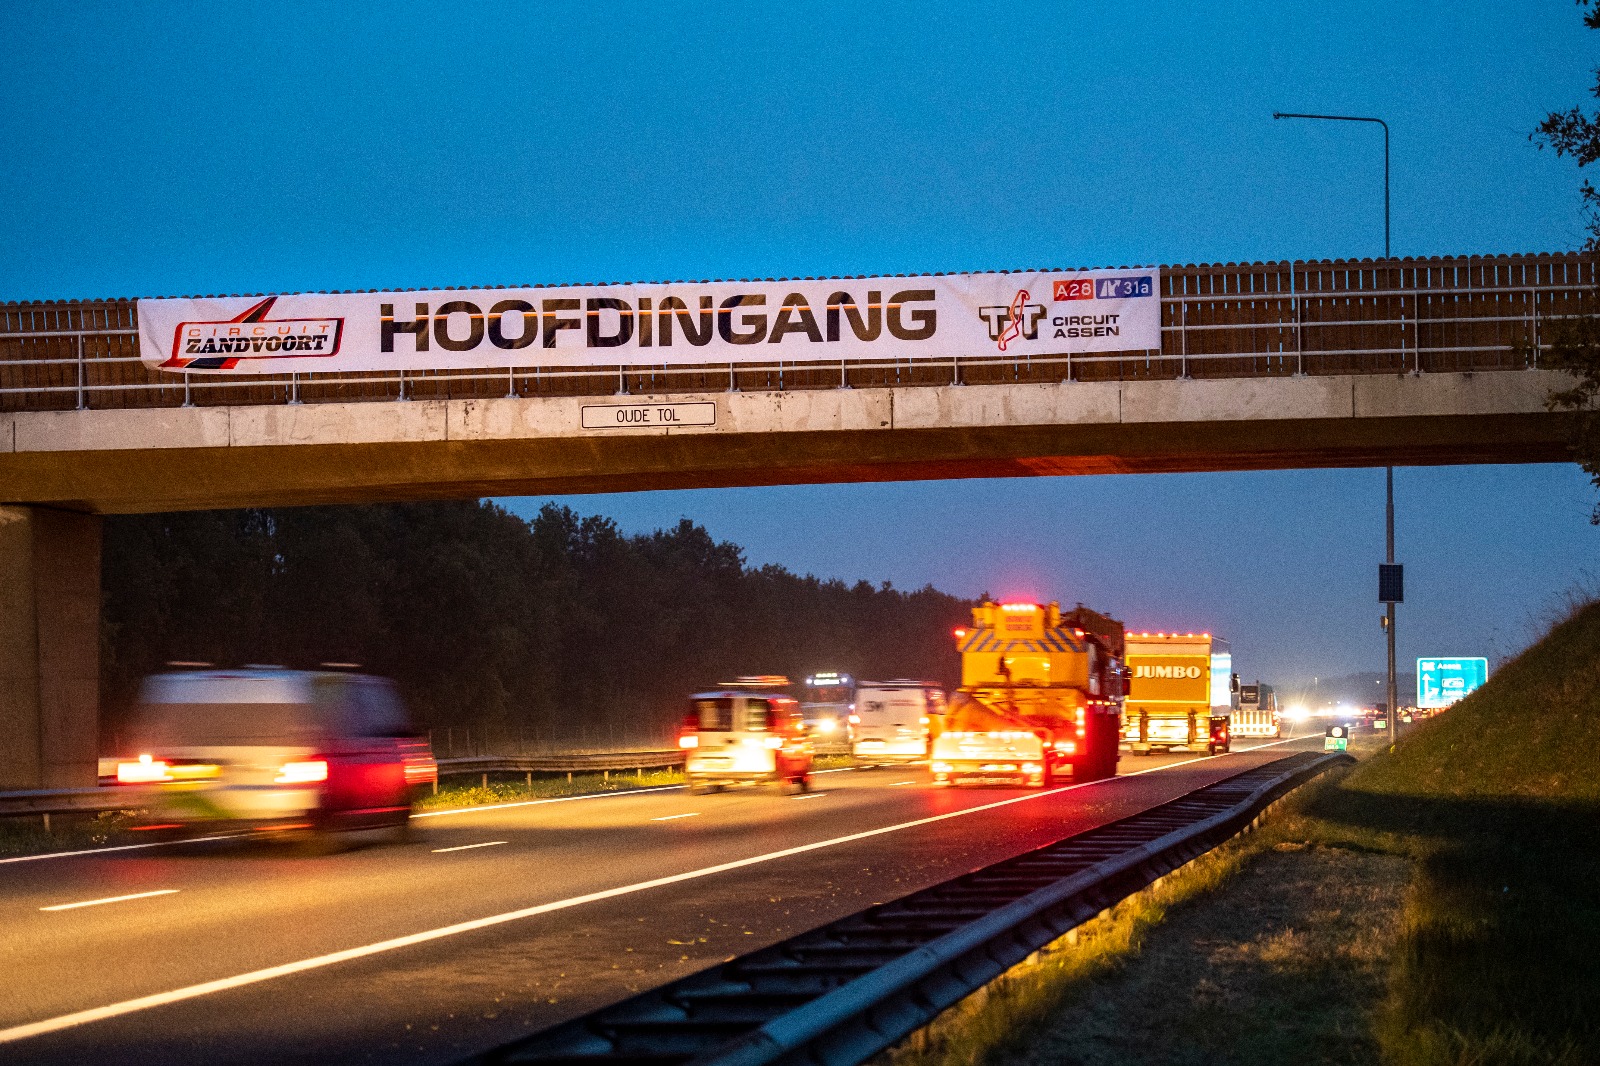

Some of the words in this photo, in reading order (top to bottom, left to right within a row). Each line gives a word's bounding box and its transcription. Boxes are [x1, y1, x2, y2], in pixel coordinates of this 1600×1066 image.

[1056, 283, 1092, 298] A28
[1124, 281, 1149, 295] 31a
[381, 290, 937, 352] HOOFDINGANG
[1052, 314, 1120, 327] CIRCUIT
[188, 325, 330, 337] CIRCUIT
[1053, 326, 1120, 339] ASSEN
[185, 335, 328, 354] ZANDVOORT
[616, 409, 650, 422] OUDE
[657, 408, 681, 421] TOL
[1134, 665, 1202, 679] JUMBO
